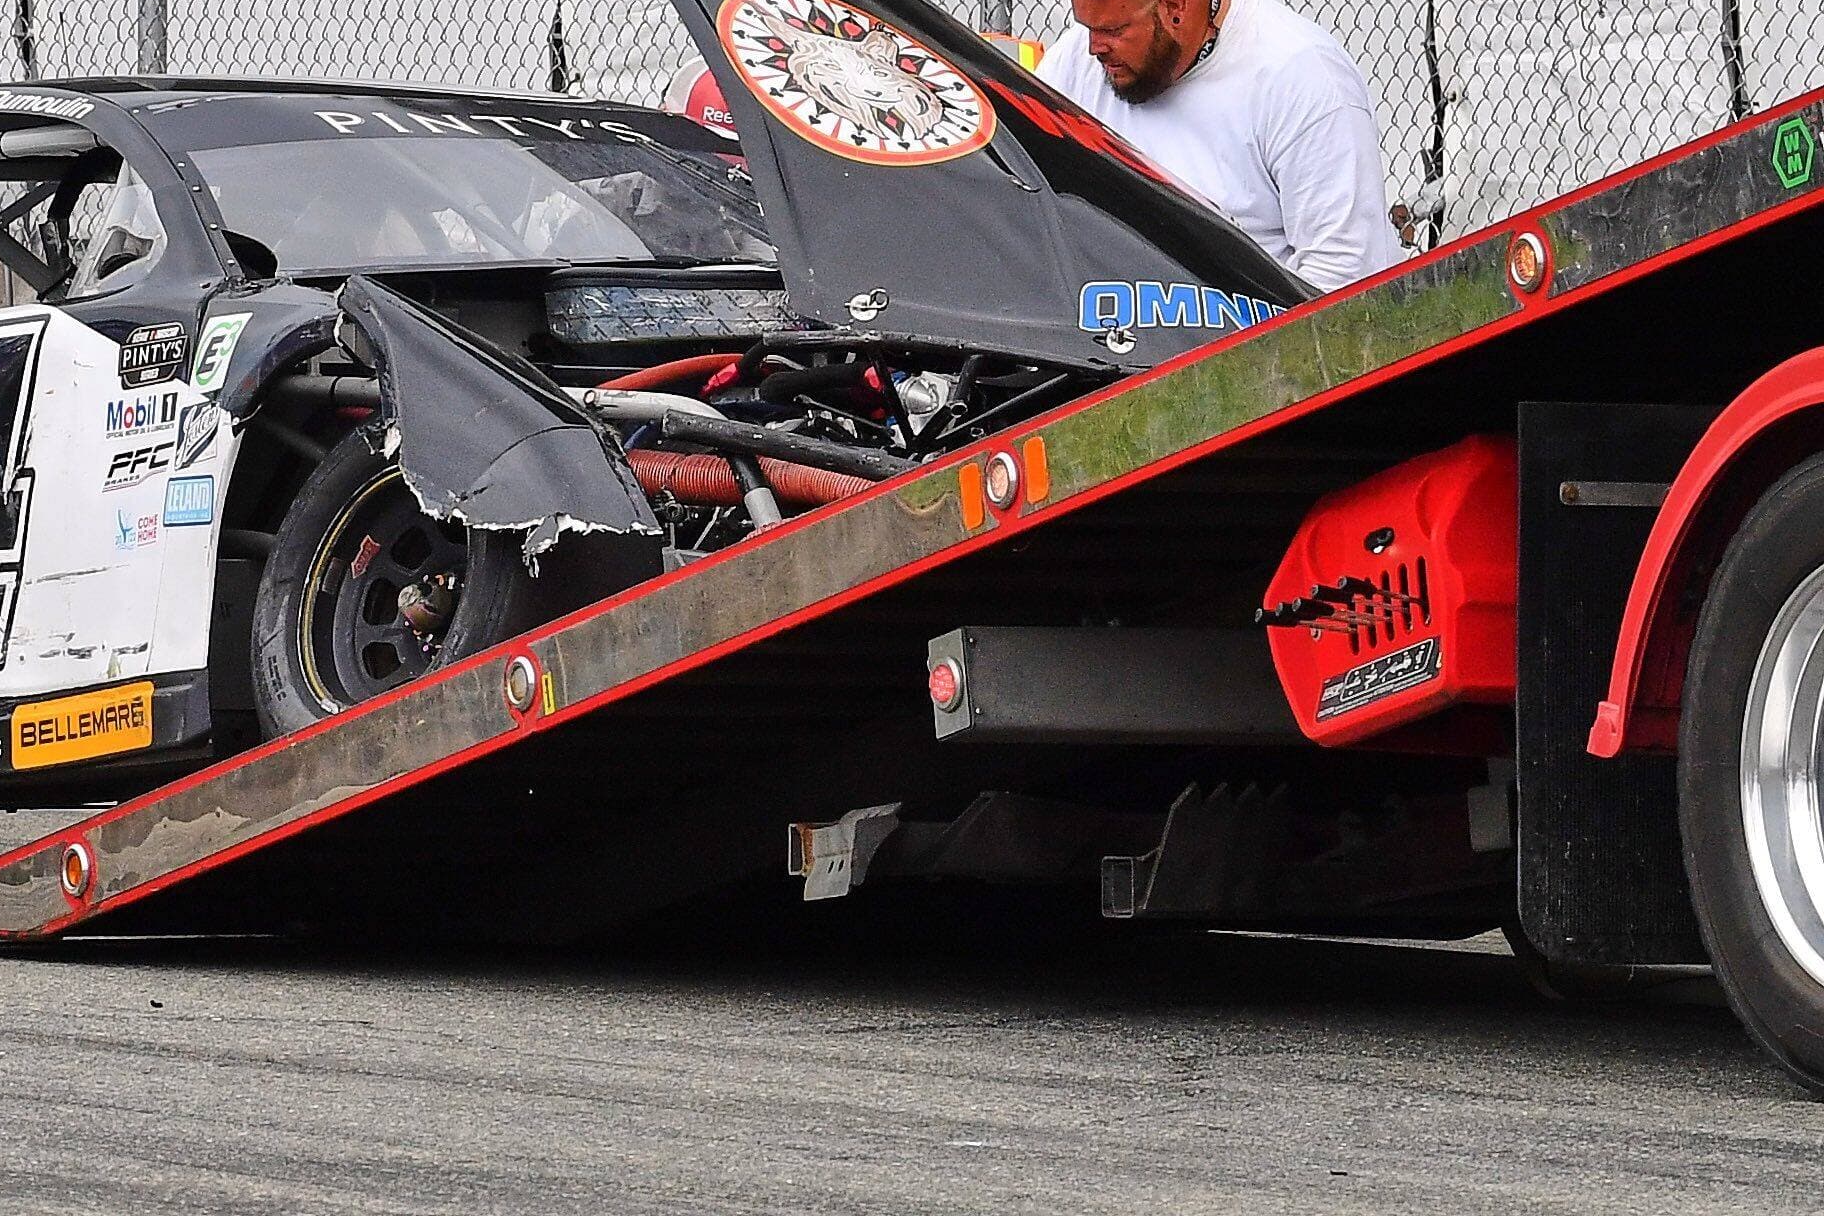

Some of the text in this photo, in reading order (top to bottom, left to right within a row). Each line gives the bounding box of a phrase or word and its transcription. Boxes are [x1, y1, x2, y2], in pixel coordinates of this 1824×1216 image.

[313, 110, 655, 143] PINTY'S
[1079, 281, 1289, 332] OMNI
[121, 339, 184, 370] PINTY'S
[106, 394, 157, 432] Mobil
[107, 441, 175, 478] PFC
